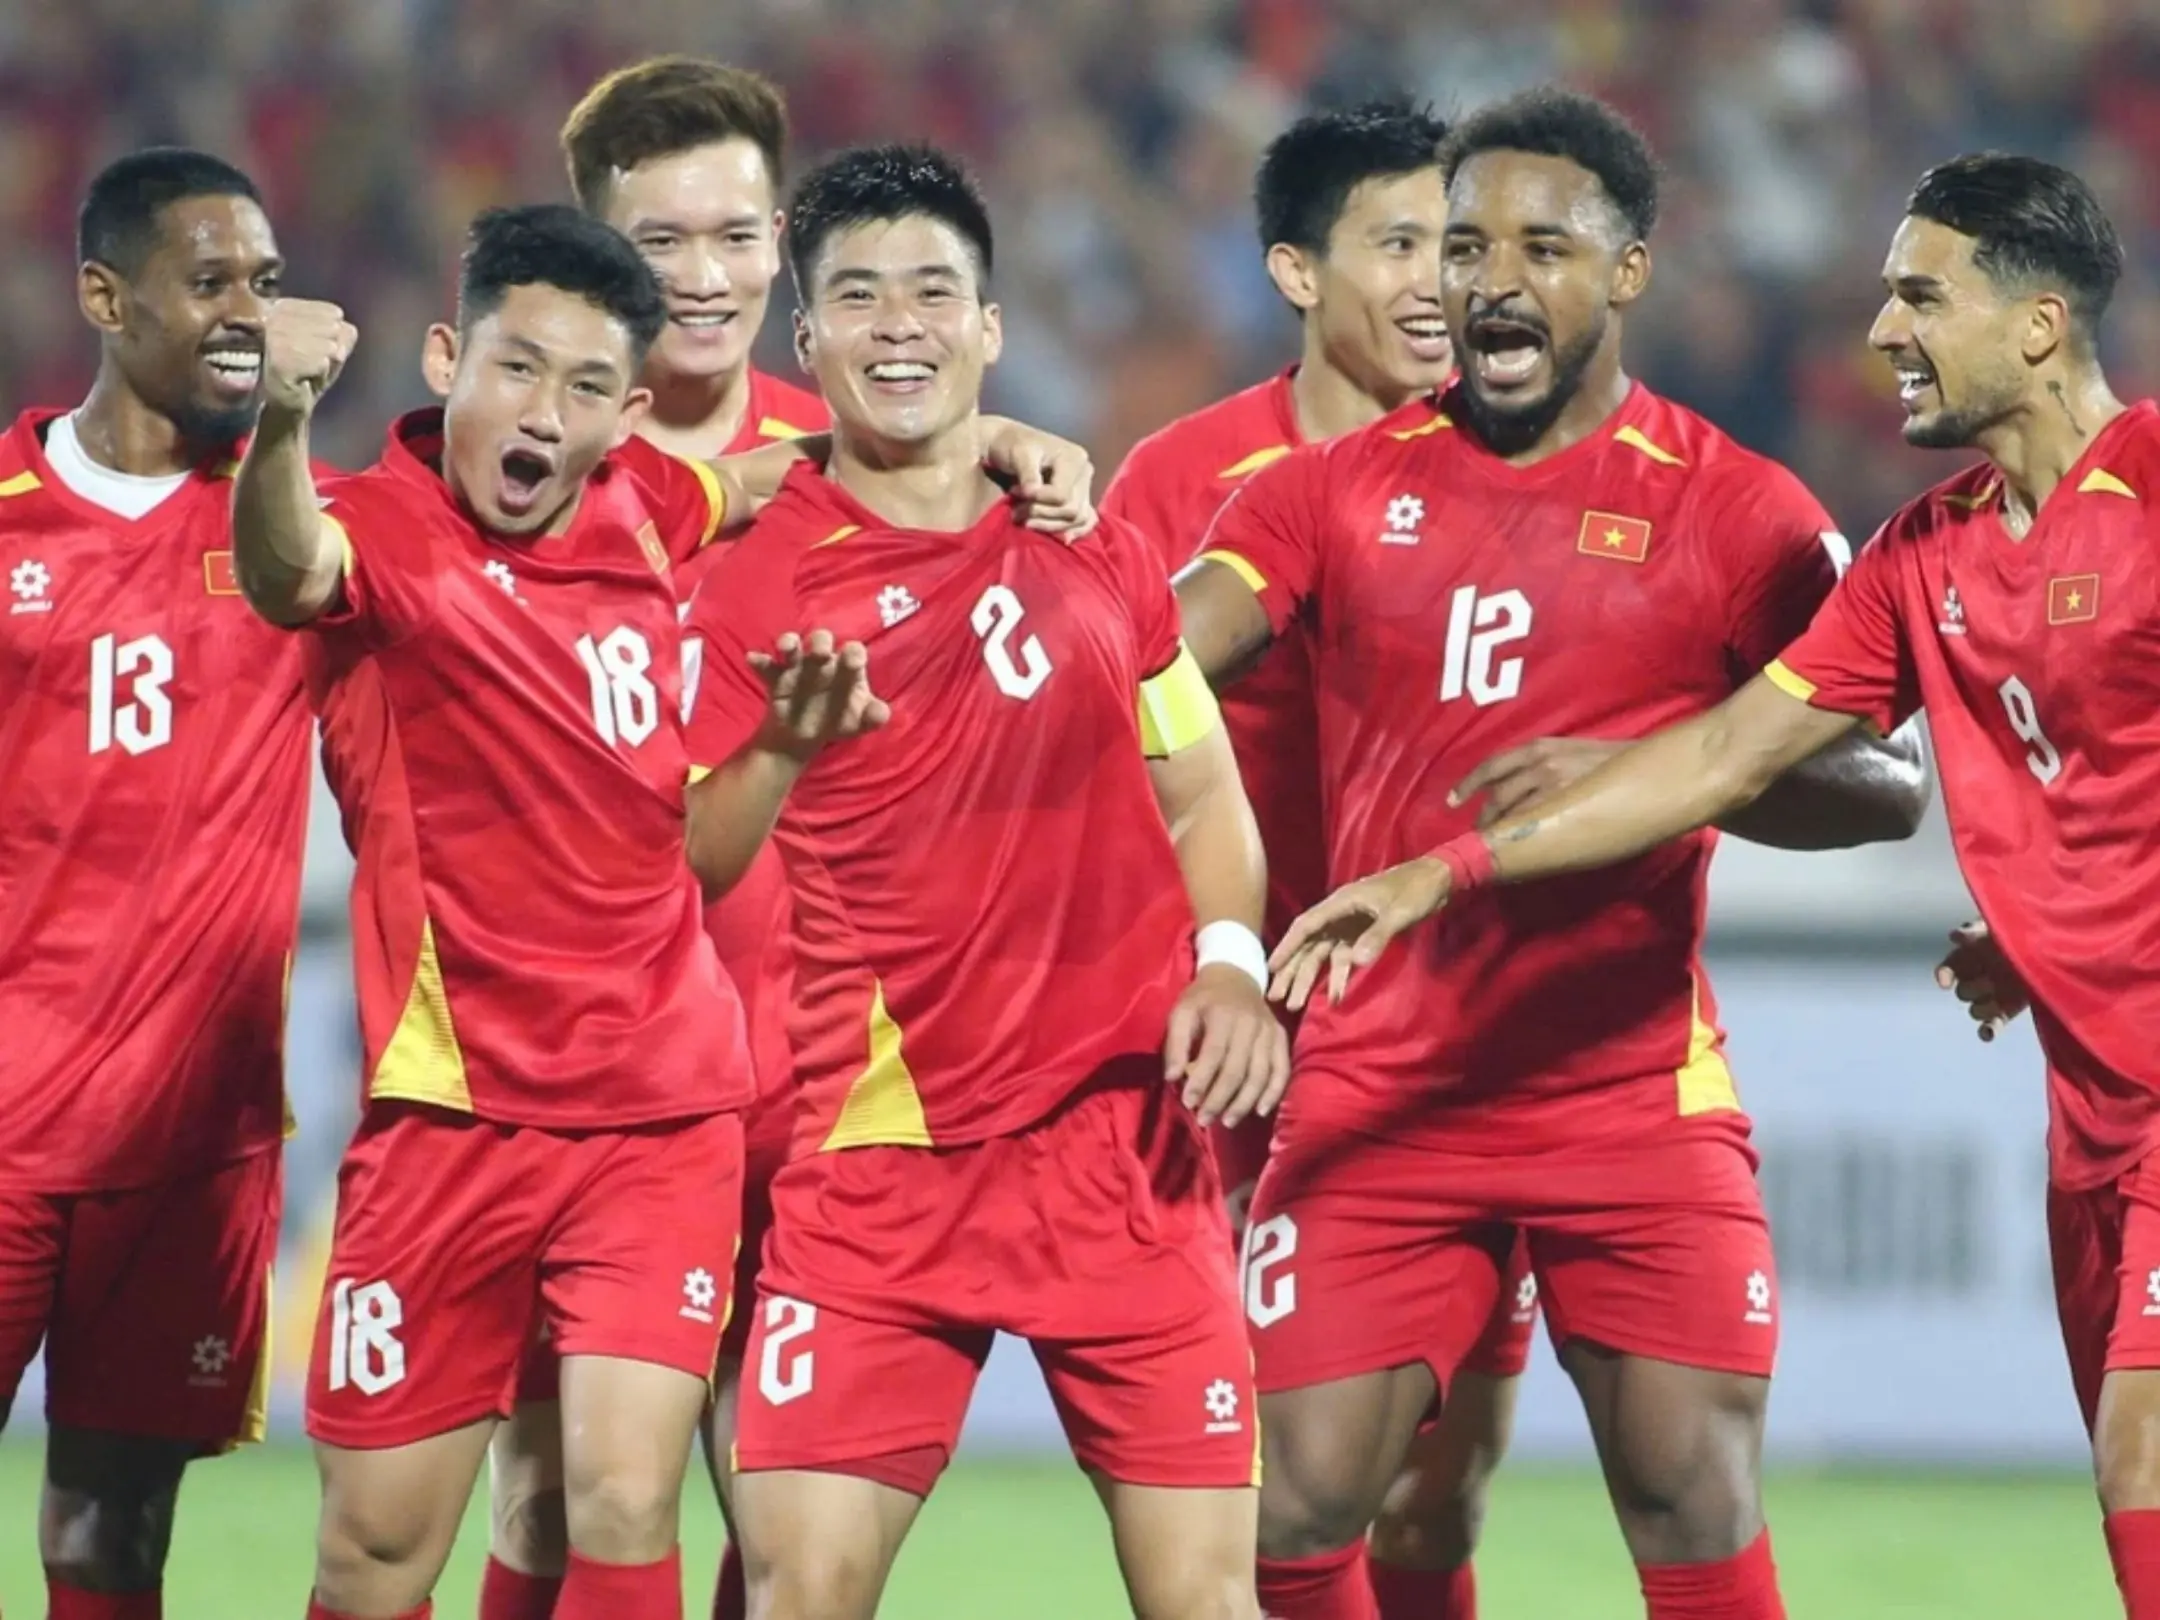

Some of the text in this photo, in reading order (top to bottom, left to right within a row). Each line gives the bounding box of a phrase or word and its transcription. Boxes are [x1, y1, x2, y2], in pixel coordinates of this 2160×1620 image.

[88, 632, 174, 756] 13
[574, 624, 659, 750] 18
[970, 584, 1054, 700] 2
[1440, 584, 1533, 707] 12
[1998, 673, 2062, 788] 9
[328, 1277, 406, 1396] 18
[758, 1295, 817, 1407] 2
